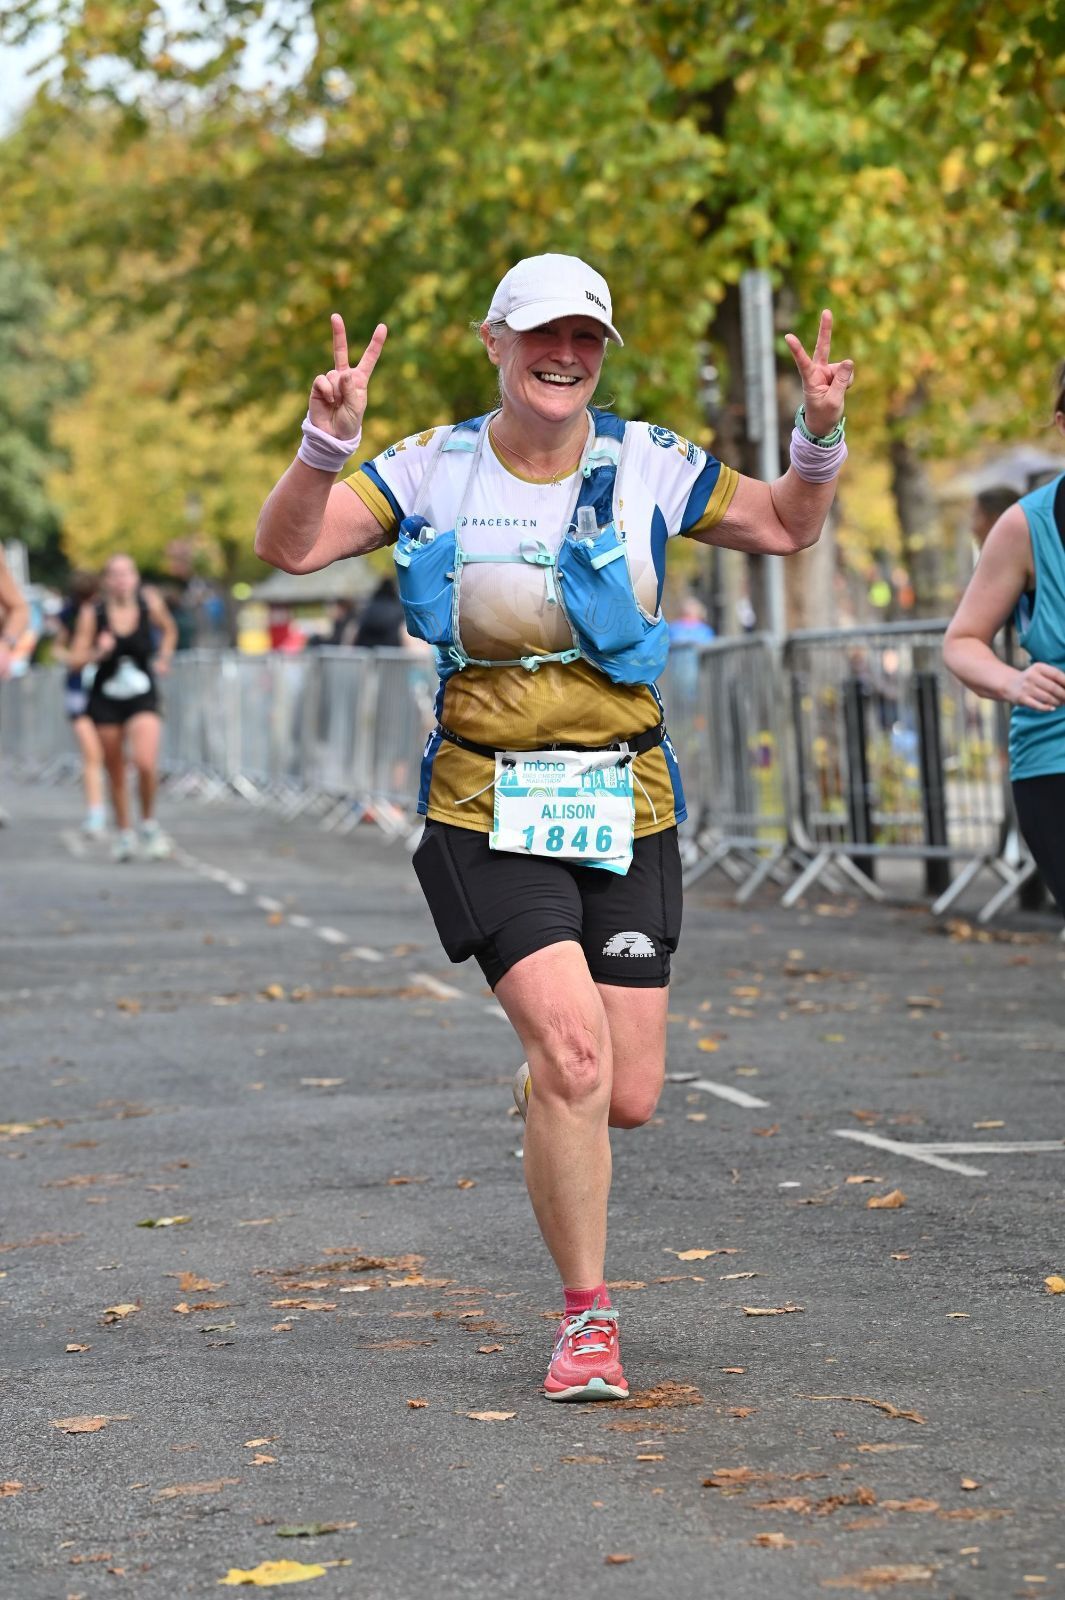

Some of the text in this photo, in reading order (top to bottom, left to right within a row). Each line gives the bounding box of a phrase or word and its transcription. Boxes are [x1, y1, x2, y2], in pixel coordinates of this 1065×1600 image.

[472, 518, 537, 527] RACESKIN
[523, 760, 565, 772] mbna
[541, 804, 596, 819] ALISON
[522, 825, 613, 853] 1846
